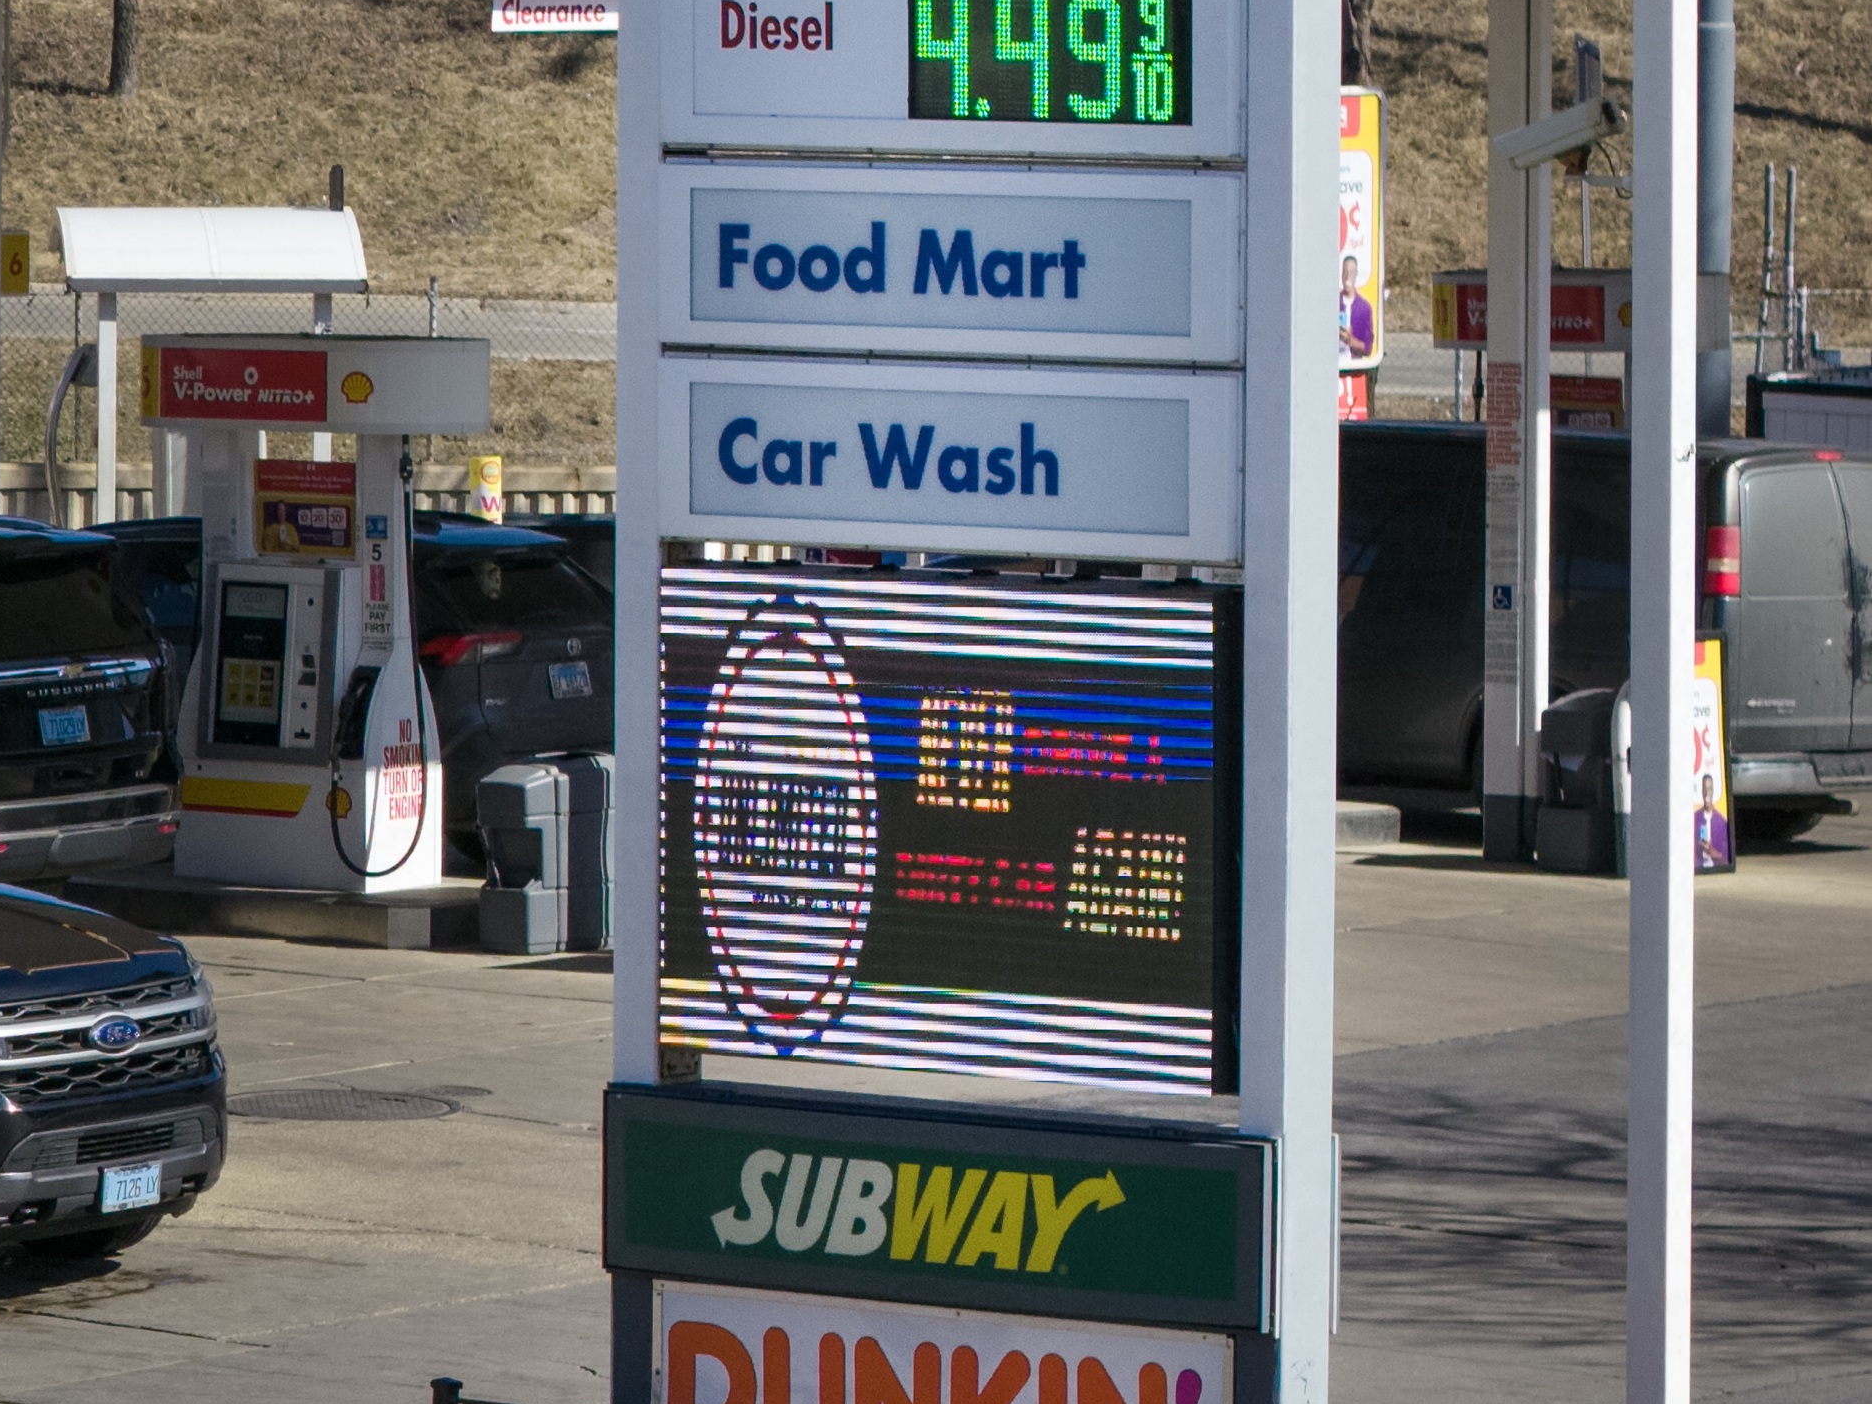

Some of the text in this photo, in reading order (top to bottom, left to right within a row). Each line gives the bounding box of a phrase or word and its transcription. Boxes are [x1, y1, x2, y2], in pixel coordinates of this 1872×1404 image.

[501, 0, 605, 25] Clearance
[720, 0, 834, 51] Diesel
[9, 251, 24, 277] 6
[719, 221, 1086, 299] Food Mart
[172, 366, 202, 381] Shell
[172, 381, 252, 403] V-Power
[718, 417, 1060, 497] Car Wash
[372, 543, 382, 562] 5
[365, 622, 391, 634] FIRST
[369, 611, 386, 621] PAY
[399, 718, 412, 743] NO
[383, 744, 422, 770] SMOKIN
[383, 770, 408, 795] TURN
[117, 1174, 159, 1200] 7126 LY
[710, 1148, 1127, 1274] SUBWAY
